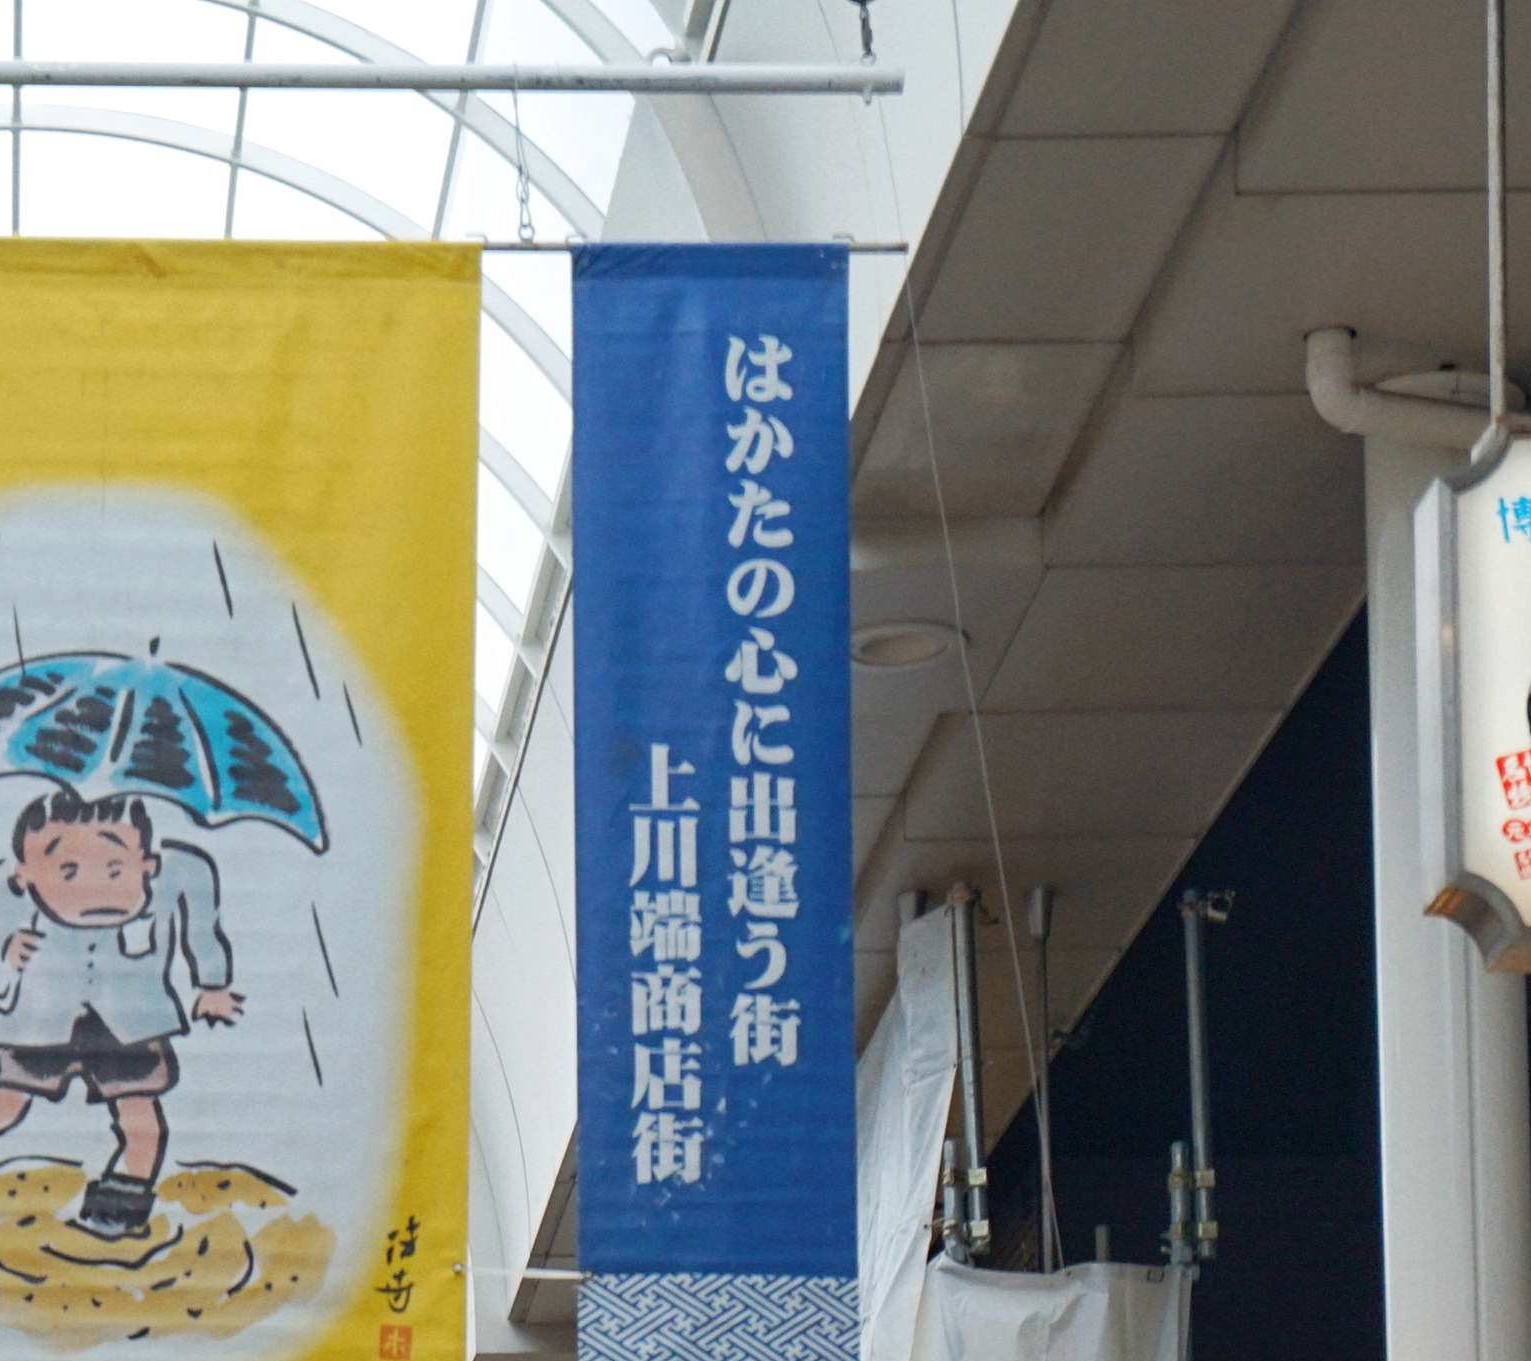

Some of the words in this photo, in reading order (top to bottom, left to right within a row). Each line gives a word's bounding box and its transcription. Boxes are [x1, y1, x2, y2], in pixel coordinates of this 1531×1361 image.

[629, 741, 704, 1188] 上川端商店街
[724, 334, 801, 1071] はかたの心に出逢う街
